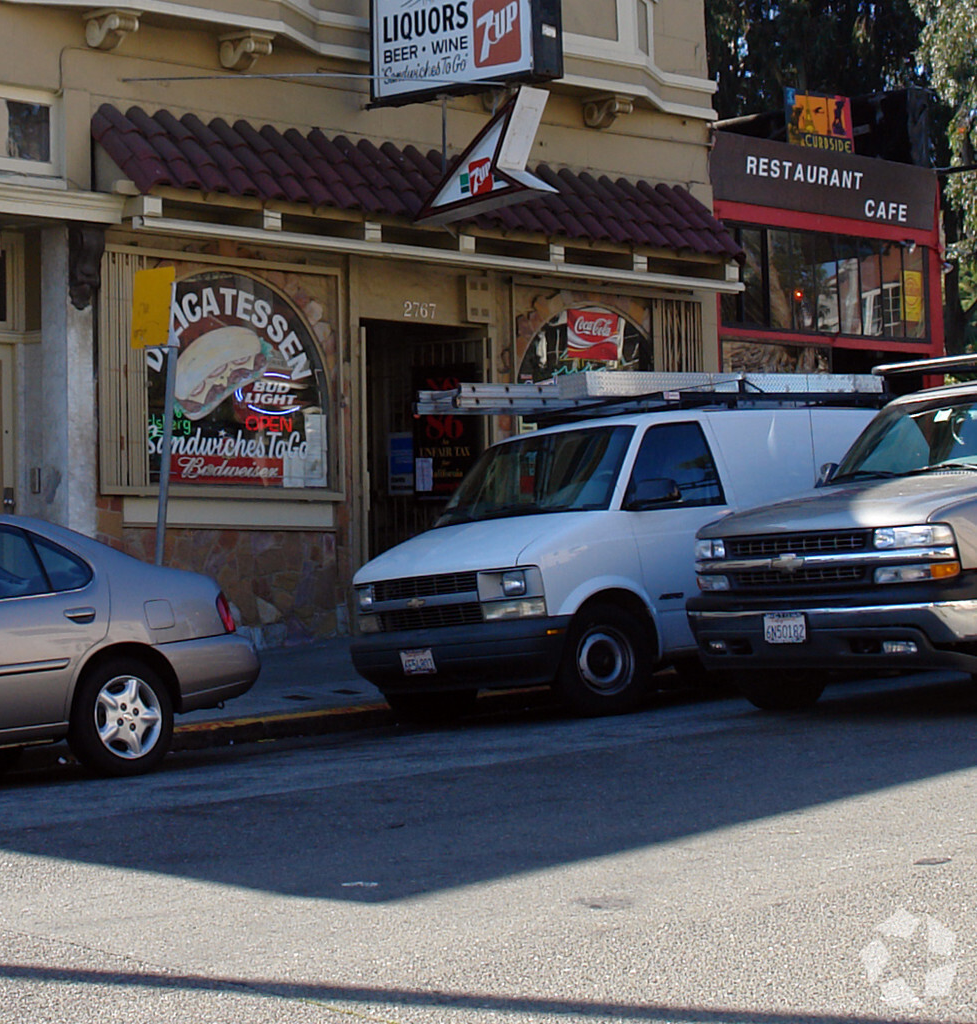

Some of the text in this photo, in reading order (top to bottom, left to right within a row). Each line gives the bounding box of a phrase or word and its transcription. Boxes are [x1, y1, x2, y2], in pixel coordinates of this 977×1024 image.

[383, 1, 468, 43] LIQUORS
[384, 36, 468, 64] BEER WINE
[805, 134, 852, 154] CURBSIDE
[746, 156, 863, 190] RESTAURANT
[864, 199, 907, 222] CAFE
[403, 300, 436, 319] 2767
[145, 287, 312, 381] DICATESSEN
[245, 392, 297, 406] LIGHT
[253, 381, 290, 394] BUD
[245, 415, 292, 433] OPEN
[266, 431, 286, 459] To
